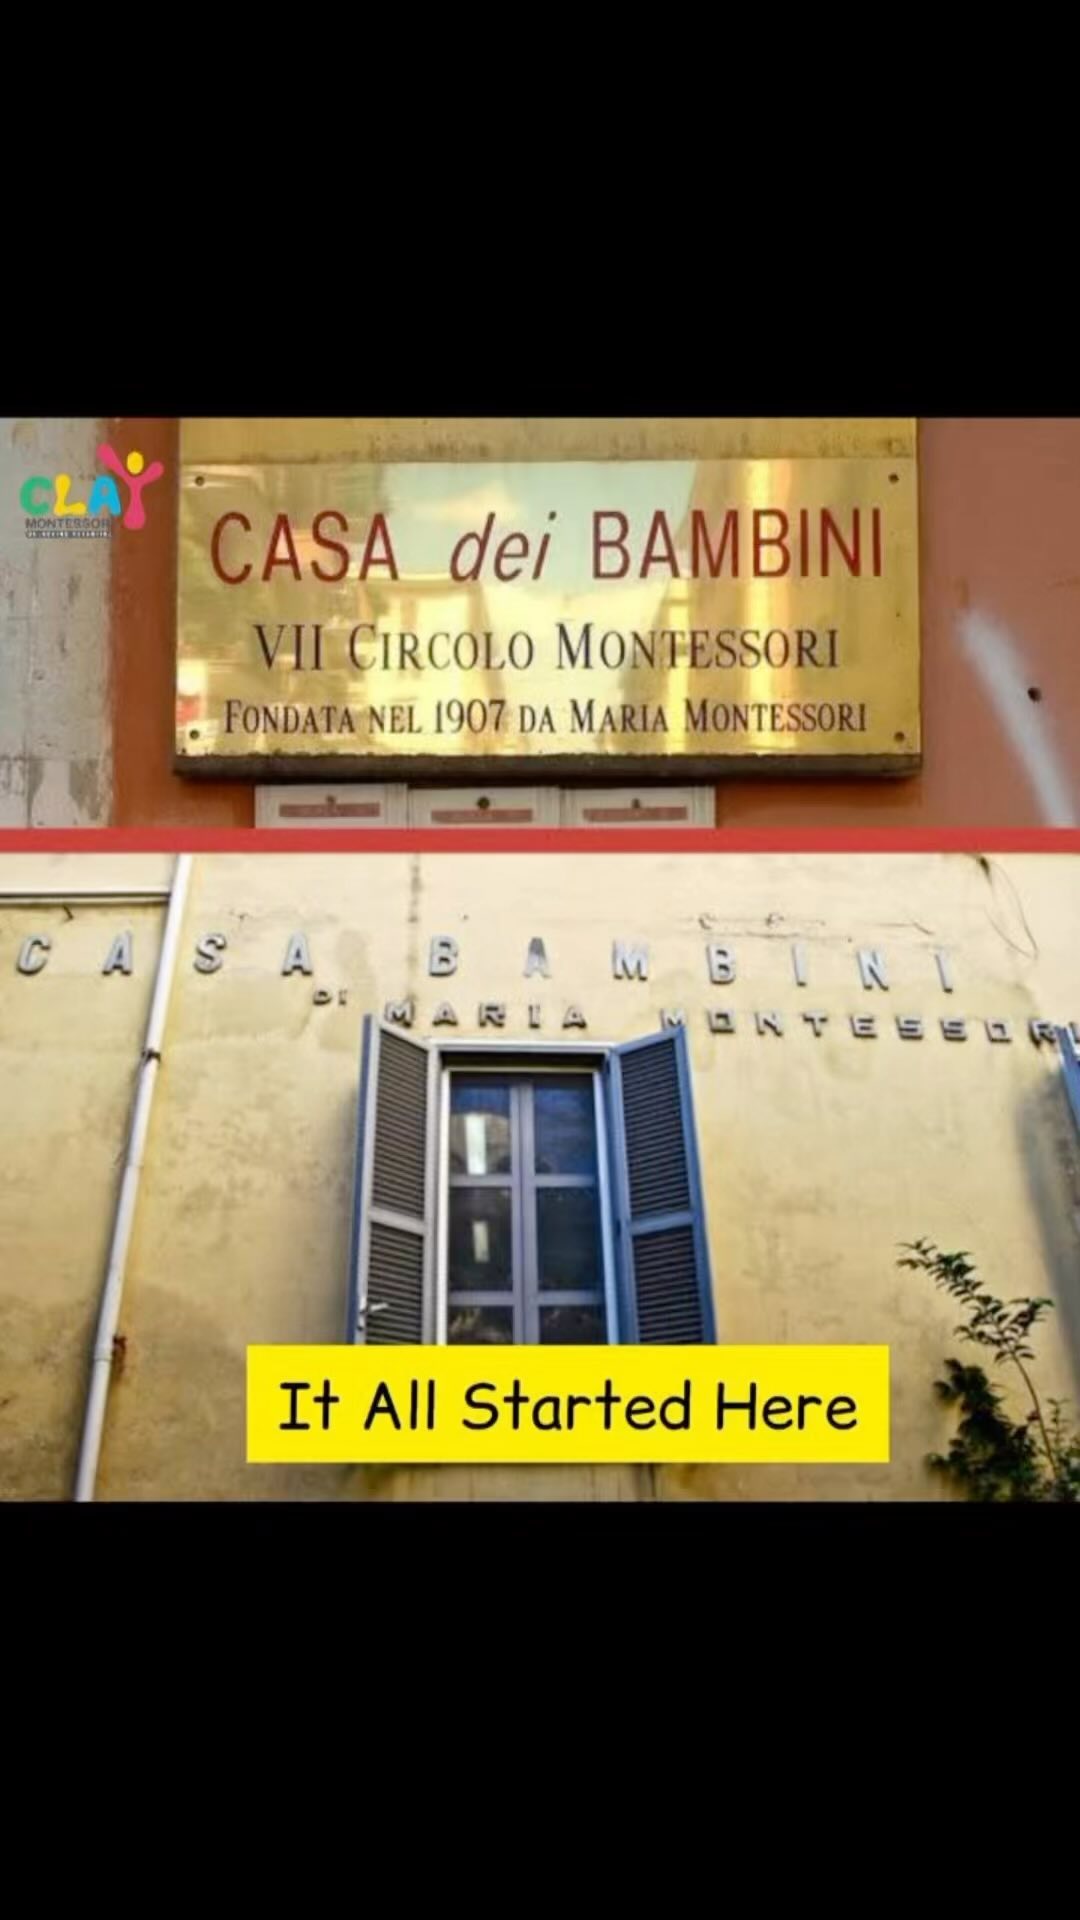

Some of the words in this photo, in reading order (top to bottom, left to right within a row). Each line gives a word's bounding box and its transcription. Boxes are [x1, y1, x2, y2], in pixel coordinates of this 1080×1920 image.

[211, 511, 399, 585] CASA
[450, 511, 557, 582] dei
[592, 507, 882, 579] BAMBINI
[253, 624, 324, 671] VII
[349, 622, 535, 672] CIRCOLO
[556, 622, 840, 670] MONTESSORI
[225, 699, 355, 734] FONDATA
[369, 704, 422, 734] NEL
[434, 698, 507, 734] 1907
[519, 704, 555, 734] DA
[570, 698, 669, 734] MARIA
[684, 697, 867, 733] MONTESSORI
[16, 931, 313, 977] CASA
[428, 934, 953, 994] BAMBINI
[384, 1000, 588, 1029] MARIA
